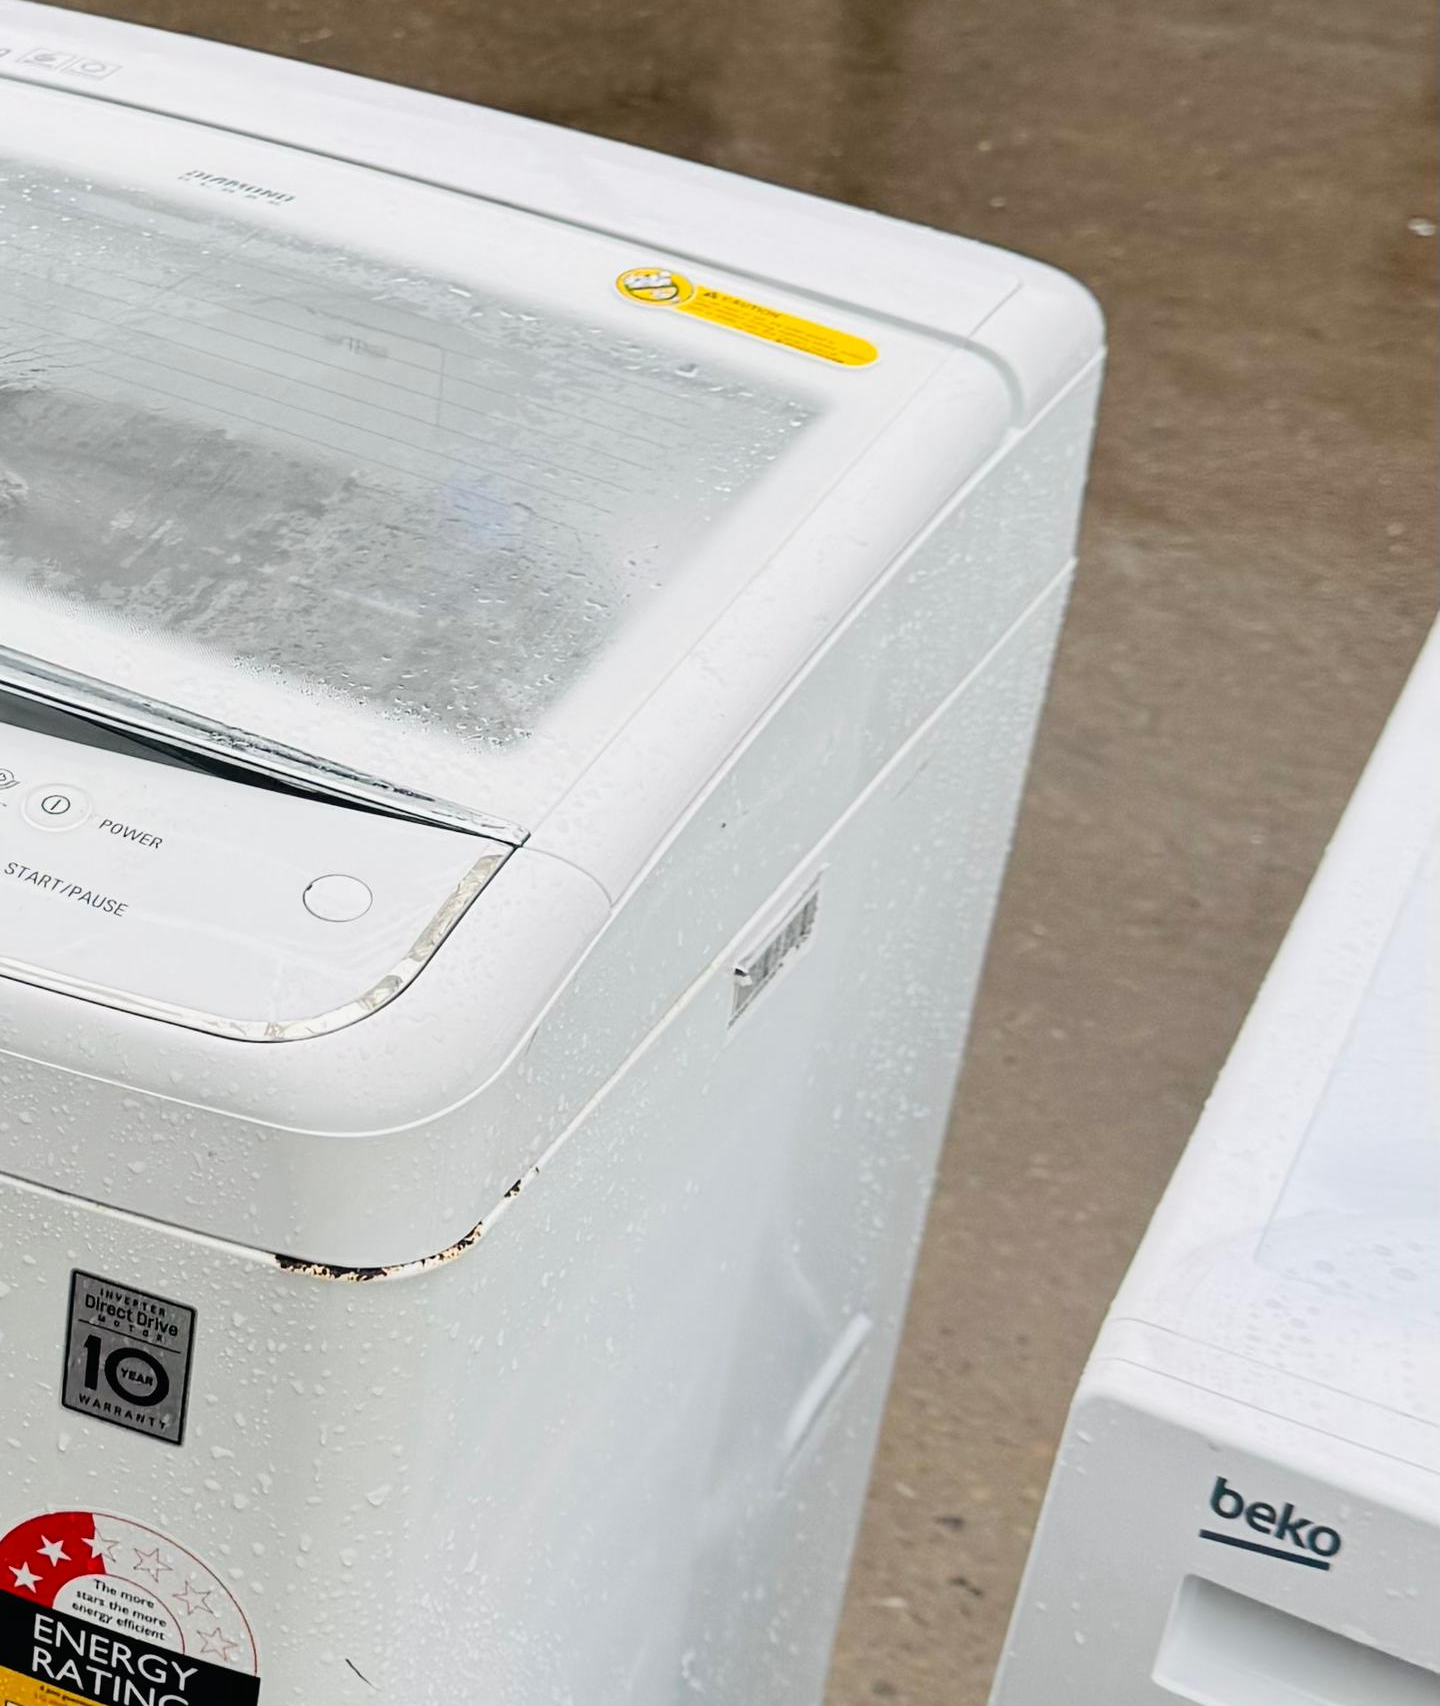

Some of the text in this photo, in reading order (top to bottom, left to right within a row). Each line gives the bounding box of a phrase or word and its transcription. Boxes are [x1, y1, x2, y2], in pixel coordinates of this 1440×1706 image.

[97, 816, 165, 851] POWER
[3, 859, 131, 918] START/PAUSE
[84, 1293, 179, 1338] Direct Drive
[99, 1287, 167, 1317] INVERTER
[97, 1314, 167, 1343] MOTOR
[83, 1334, 170, 1407] 10
[120, 1367, 155, 1387] YEAR
[78, 1392, 168, 1431] WARRANTY
[1209, 1475, 1342, 1557] beko
[75, 1590, 167, 1628] stars the more
[93, 1578, 155, 1610] The more
[71, 1601, 166, 1642] energy efficient
[34, 1612, 199, 1692] ENERGY
